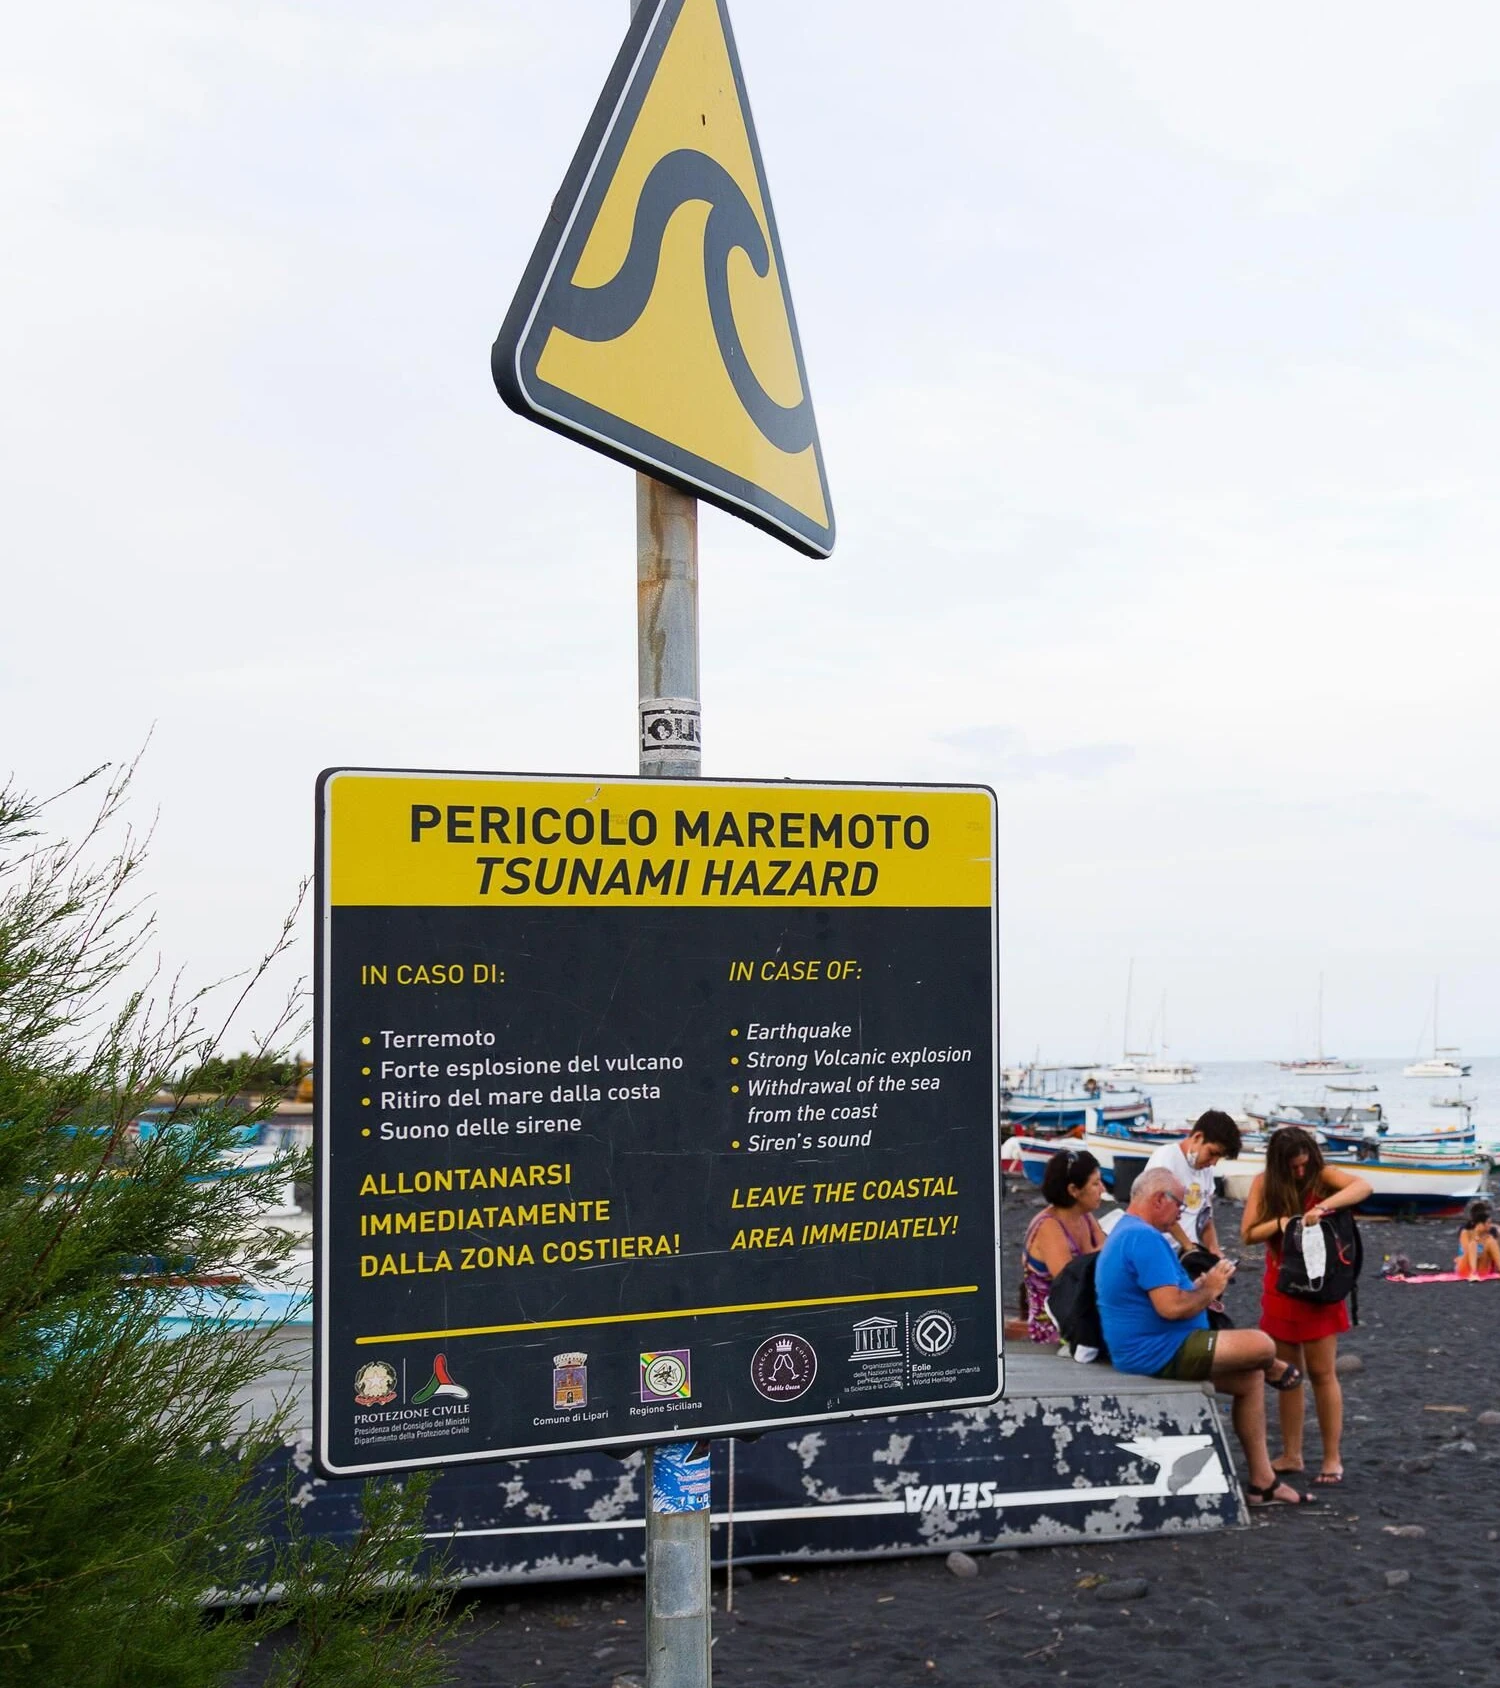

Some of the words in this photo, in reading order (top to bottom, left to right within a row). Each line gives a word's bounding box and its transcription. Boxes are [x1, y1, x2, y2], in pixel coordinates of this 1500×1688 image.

[411, 804, 657, 846] PERICOLO
[675, 809, 930, 851] MAREMOTO
[476, 856, 690, 897] TSUNAMI
[702, 859, 879, 897] HAZARD
[362, 965, 386, 985] IN
[397, 963, 463, 985] CASO
[474, 963, 505, 984] DI:
[730, 960, 754, 981] IN
[761, 960, 821, 981] CASE
[827, 959, 862, 981] OF:
[380, 1029, 495, 1050] Terremoto
[746, 1021, 851, 1043] Earthquake
[381, 1061, 439, 1081] Forte
[447, 1057, 560, 1082] esplosione
[568, 1054, 600, 1073] del
[606, 1053, 684, 1073] vulcano
[746, 1051, 807, 1071] Strong
[815, 1047, 886, 1067] Volcanic
[891, 1045, 972, 1068] explosion
[381, 1090, 440, 1110] Ritiro
[448, 1088, 481, 1108] del
[488, 1090, 544, 1106] mare
[550, 1083, 601, 1104] dalla
[607, 1083, 661, 1102] costa
[747, 1076, 851, 1097] Withdrawal
[857, 1075, 875, 1093] of
[879, 1075, 906, 1093] the
[911, 1077, 941, 1091] sea
[747, 1105, 792, 1124] from
[797, 1104, 826, 1122] the
[830, 1103, 879, 1121] coast
[380, 1121, 450, 1140] Suono
[456, 1117, 510, 1138] delle
[515, 1115, 582, 1135] sirene
[747, 1132, 812, 1153] Siren's
[816, 1130, 872, 1149] sound
[360, 1163, 572, 1196] ALLONTANARSI
[731, 1184, 805, 1209] LEAVE
[813, 1181, 857, 1204] THE
[862, 1176, 959, 1202] COASTAL
[360, 1200, 610, 1236] IMMEDIATAMENTE
[730, 1227, 795, 1250] AREA
[801, 1216, 959, 1246] IMMEDIATELY!
[360, 1249, 452, 1278] DALLA
[460, 1243, 535, 1271] ZONA
[542, 1234, 681, 1264] COSTIERA!
[855, 1327, 896, 1351] UNESCO
[911, 1363, 932, 1372] Eolie
[911, 1371, 944, 1379] Patrimonio
[912, 1378, 930, 1386] World
[931, 1375, 957, 1384] Heritage
[354, 1407, 429, 1424] PROTEZIONE
[432, 1403, 470, 1416] CIVILE
[533, 1415, 571, 1427] Comune
[573, 1413, 581, 1422] di
[583, 1410, 609, 1423] Lipari
[629, 1404, 665, 1416] Regione
[666, 1401, 703, 1412] Siciliana
[354, 1426, 390, 1436] Presidenza
[391, 1423, 402, 1432] del
[402, 1421, 433, 1431] Consiglio
[445, 1417, 470, 1426] Ministri
[354, 1434, 398, 1446] Dipartimento
[398, 1432, 415, 1441] della
[416, 1428, 450, 1438] Protezione
[450, 1425, 470, 1435] Civile
[904, 1481, 997, 1513] SELVA
